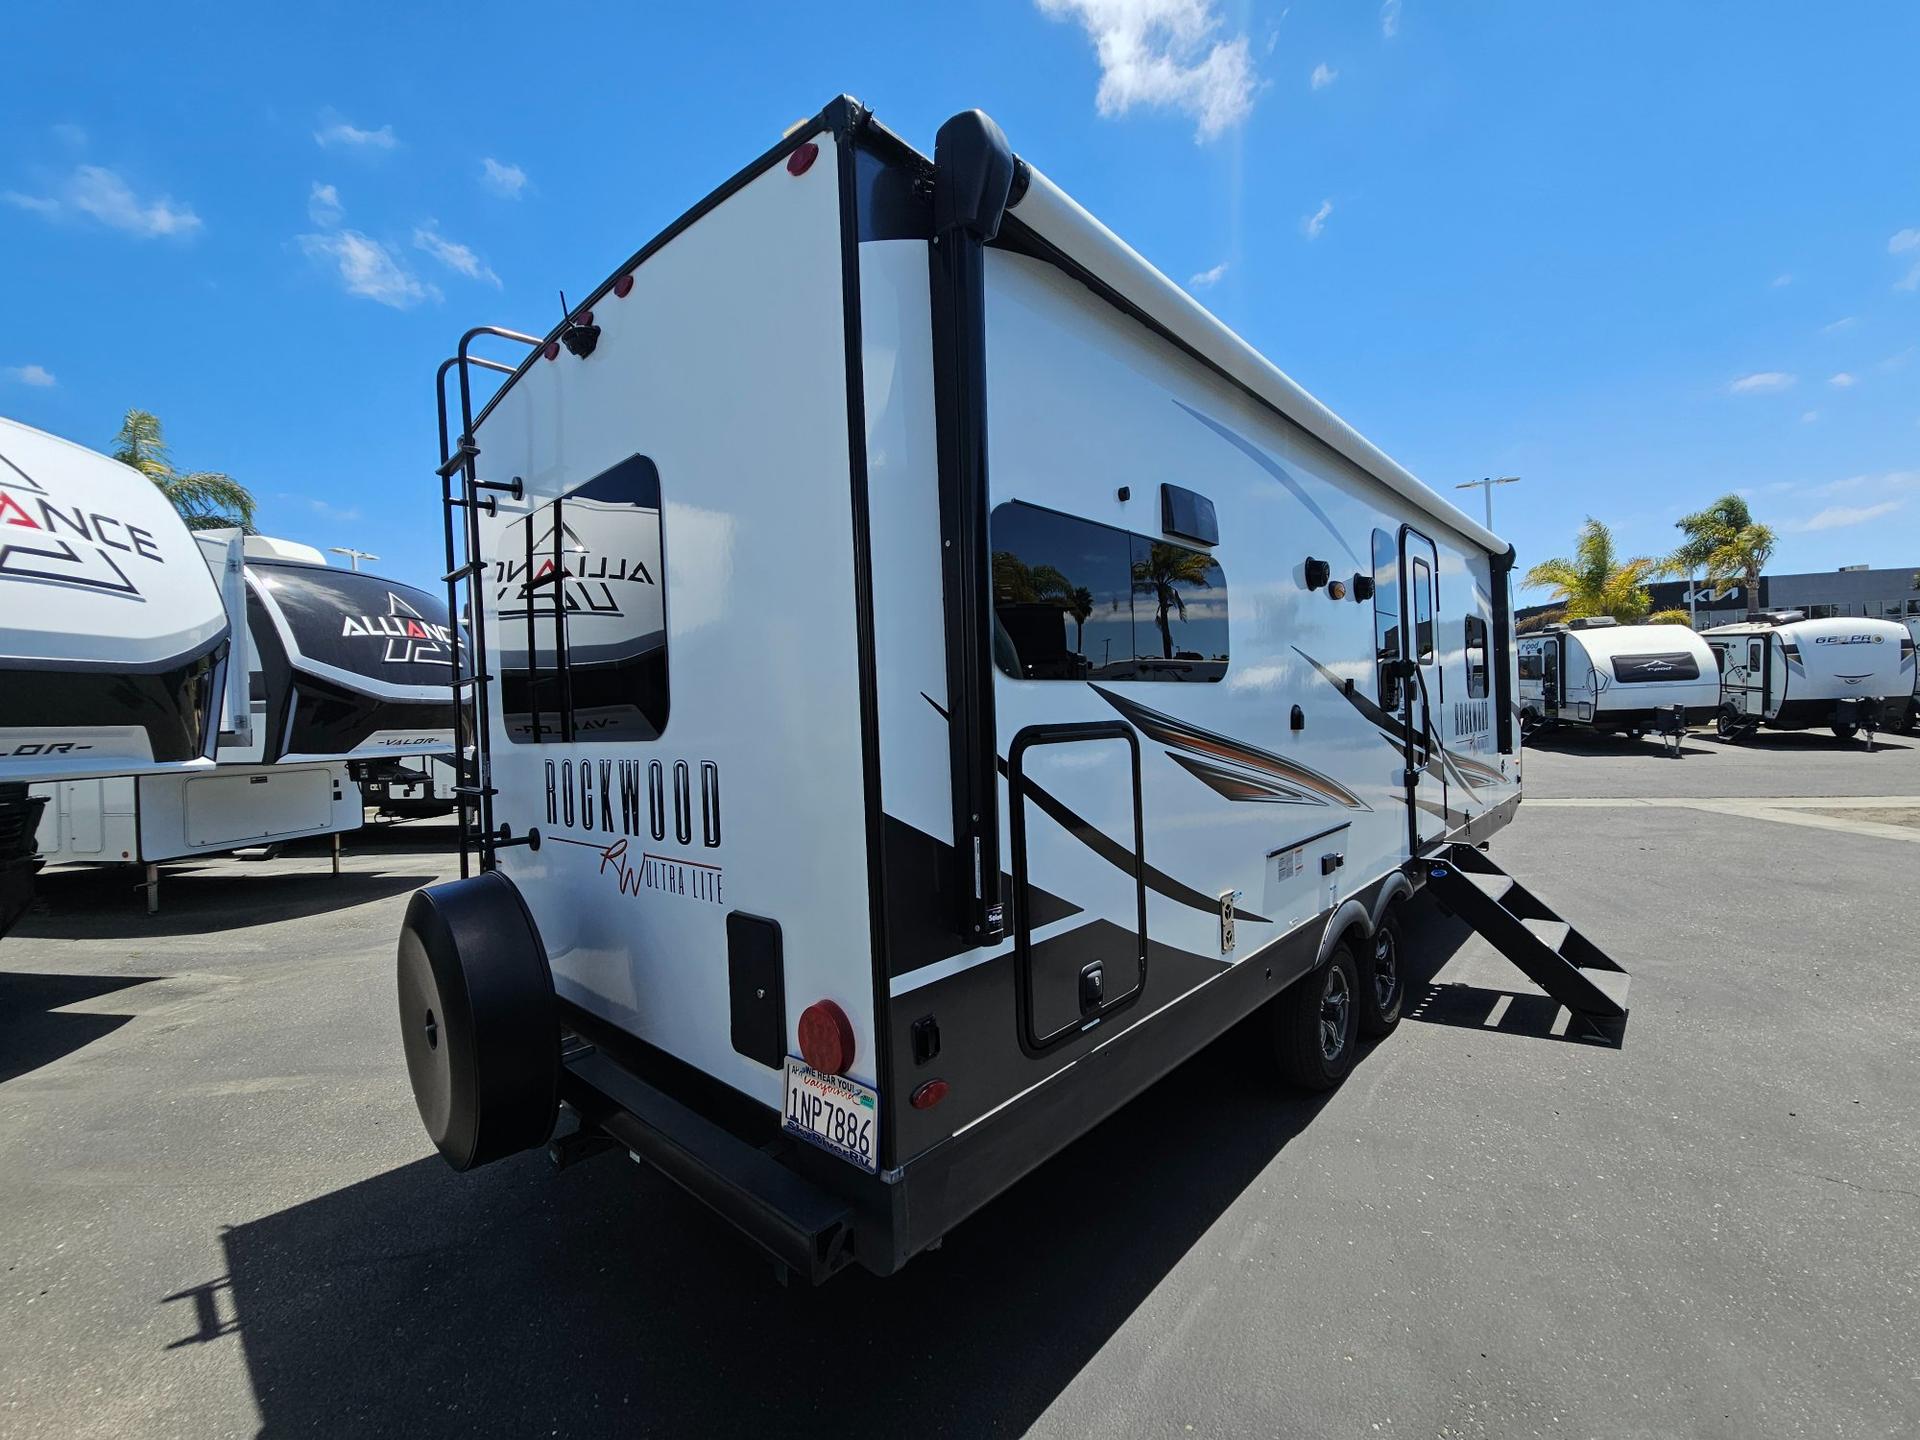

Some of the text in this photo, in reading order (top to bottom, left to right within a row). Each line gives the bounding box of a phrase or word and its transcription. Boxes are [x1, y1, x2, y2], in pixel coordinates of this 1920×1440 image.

[342, 615, 465, 649] ALLIANC
[545, 758, 721, 848] ROCKWOOD
[646, 860, 723, 905] ULTRA LITE
[805, 1065, 816, 1077] WE
[818, 1071, 836, 1086] HEAR
[790, 1087, 871, 1157] 1NP7886
